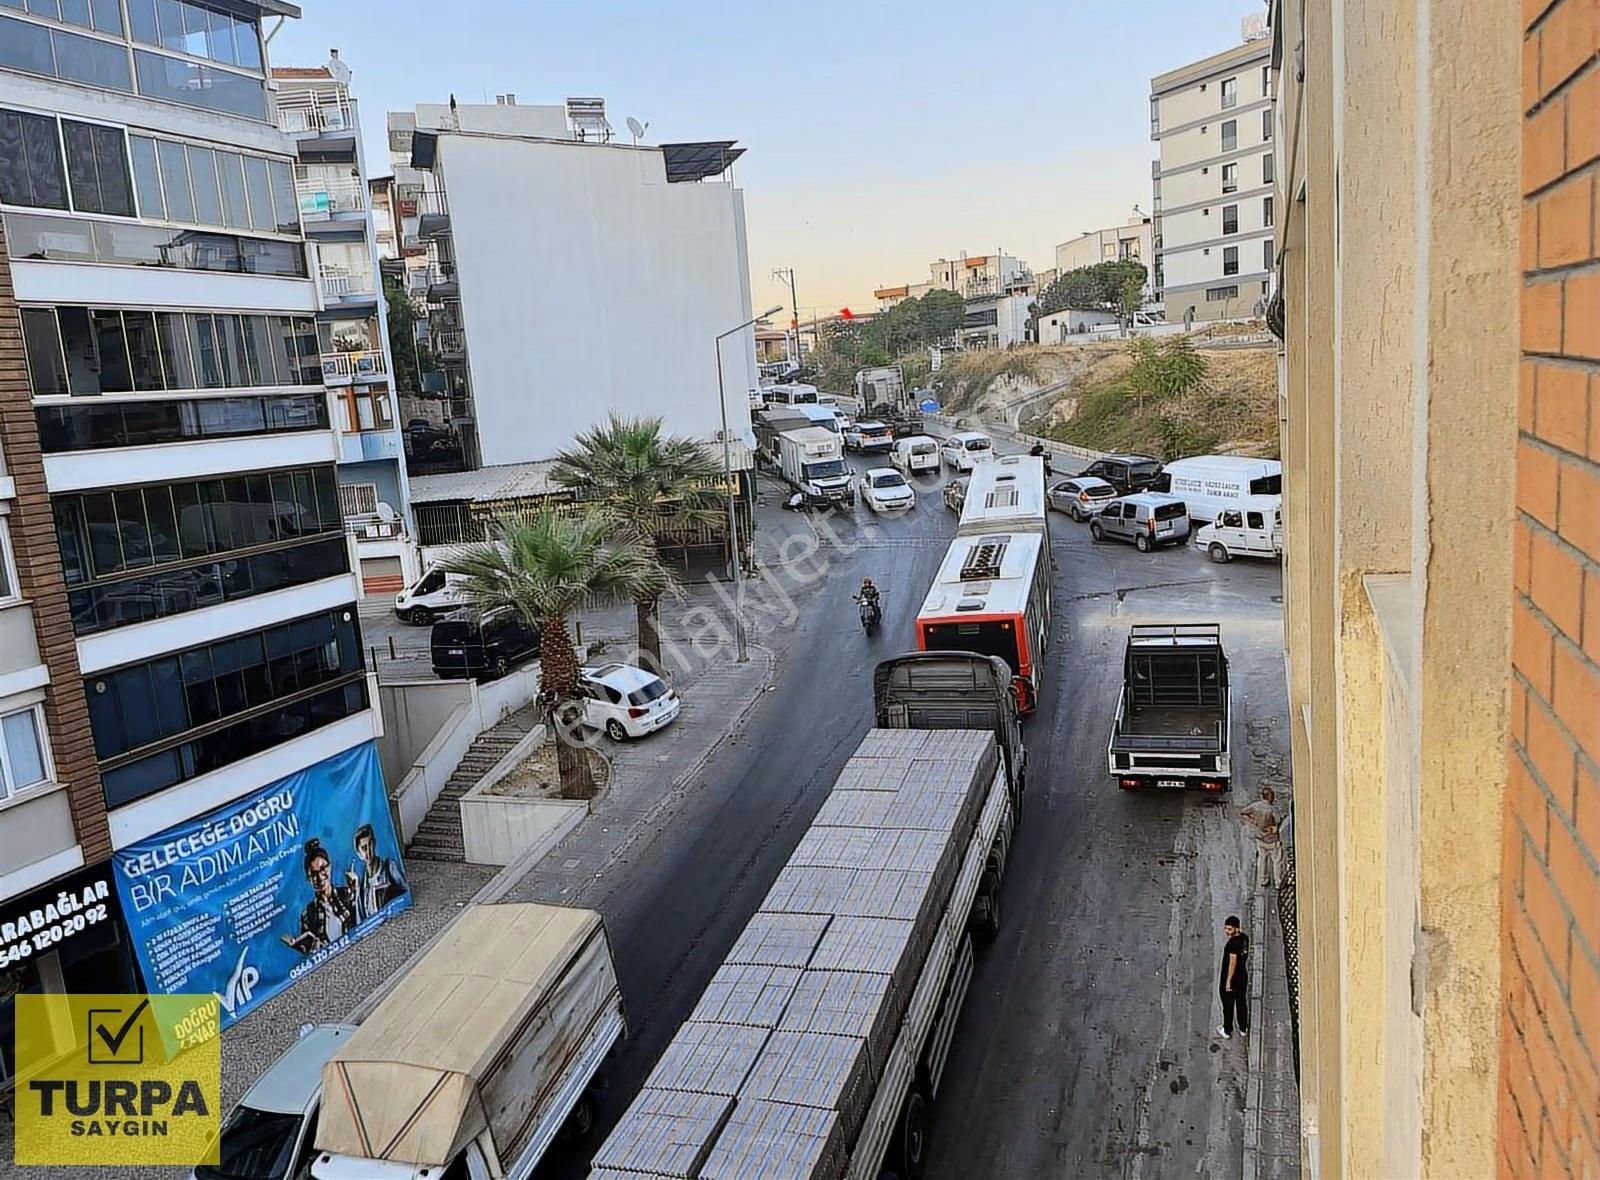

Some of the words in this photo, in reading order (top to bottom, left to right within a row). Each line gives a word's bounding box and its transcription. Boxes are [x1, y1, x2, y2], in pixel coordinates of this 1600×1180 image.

[123, 821, 229, 878] GELECEĞE
[230, 789, 293, 833] DOĞRU
[130, 873, 177, 912] BİR
[180, 842, 243, 893] ADIM
[247, 813, 299, 861] ATIN!
[0, 880, 109, 945] RABAĞLAR
[175, 999, 217, 1039] DOĞRU
